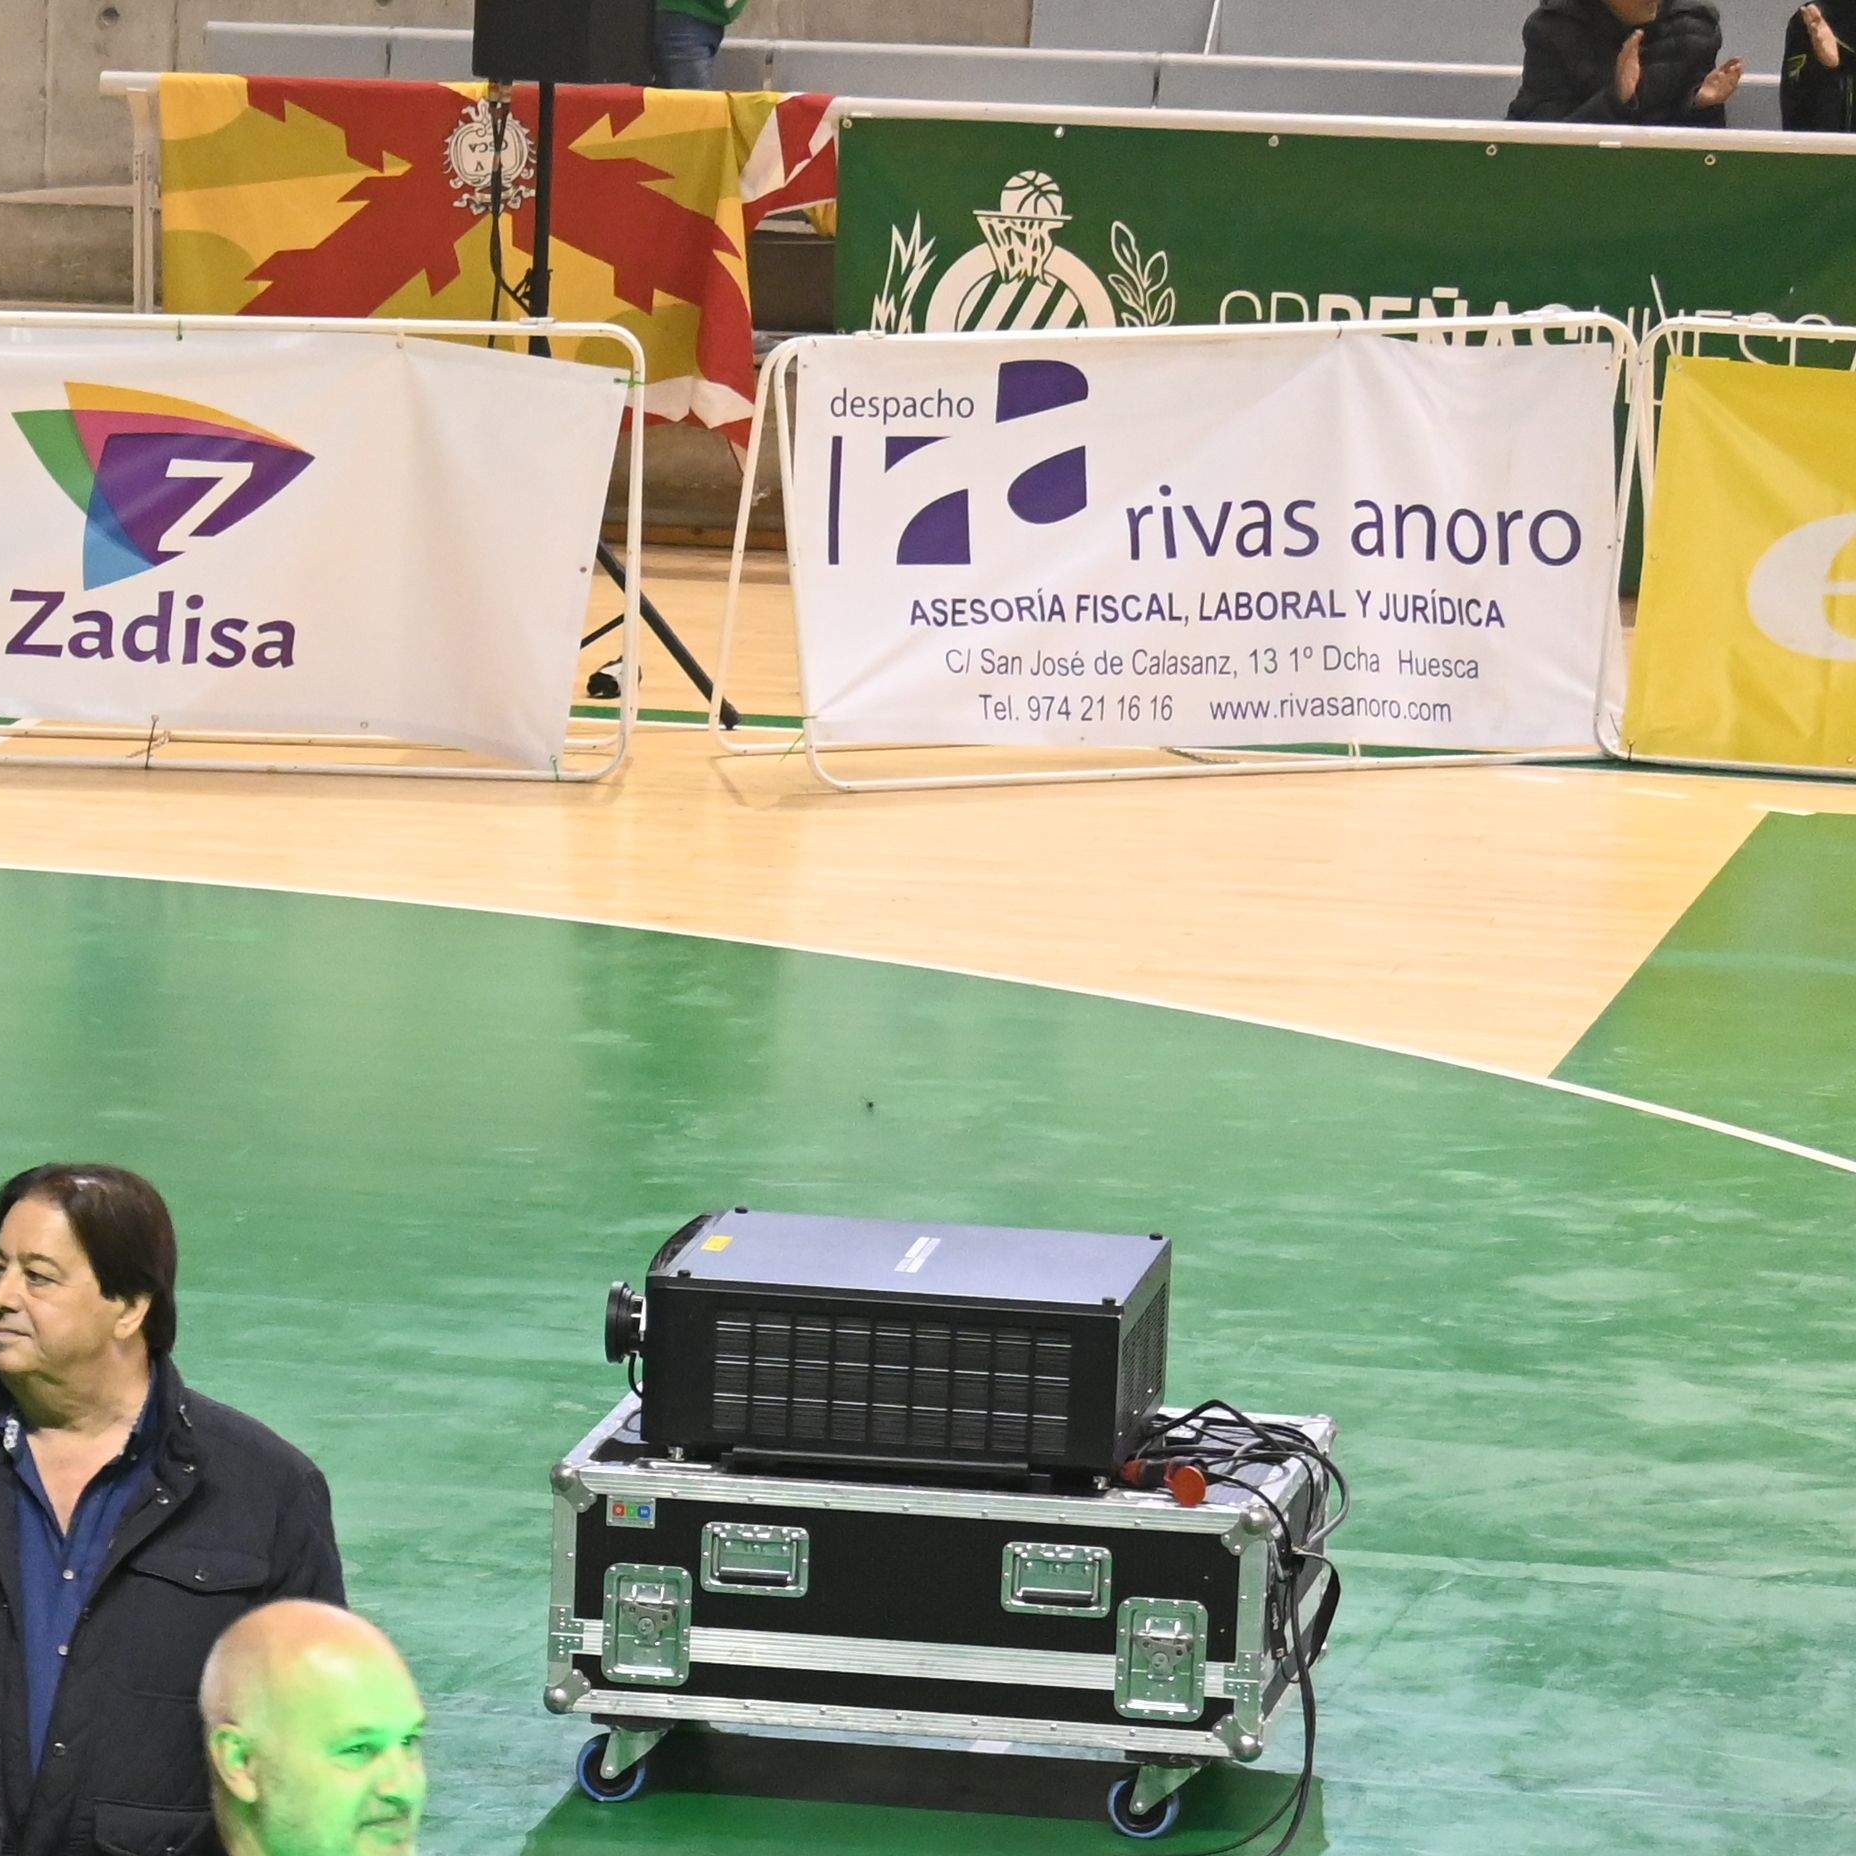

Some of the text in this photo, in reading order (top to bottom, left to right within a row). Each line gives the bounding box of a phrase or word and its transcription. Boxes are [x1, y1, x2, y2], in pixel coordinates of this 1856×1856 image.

[830, 388, 975, 425] despacho
[1125, 484, 1582, 566] rivas anoro
[910, 588, 1506, 629] ASESORÍA FISCAL, LABORAL Y JURÍDICA
[5, 588, 296, 669] Zadisa
[945, 645, 1479, 679] C/ San José de Calasanz, 13 1º Dcha Huesca
[979, 693, 1452, 723] Tel. 974 21 16 16 www.rivasanoro.com
